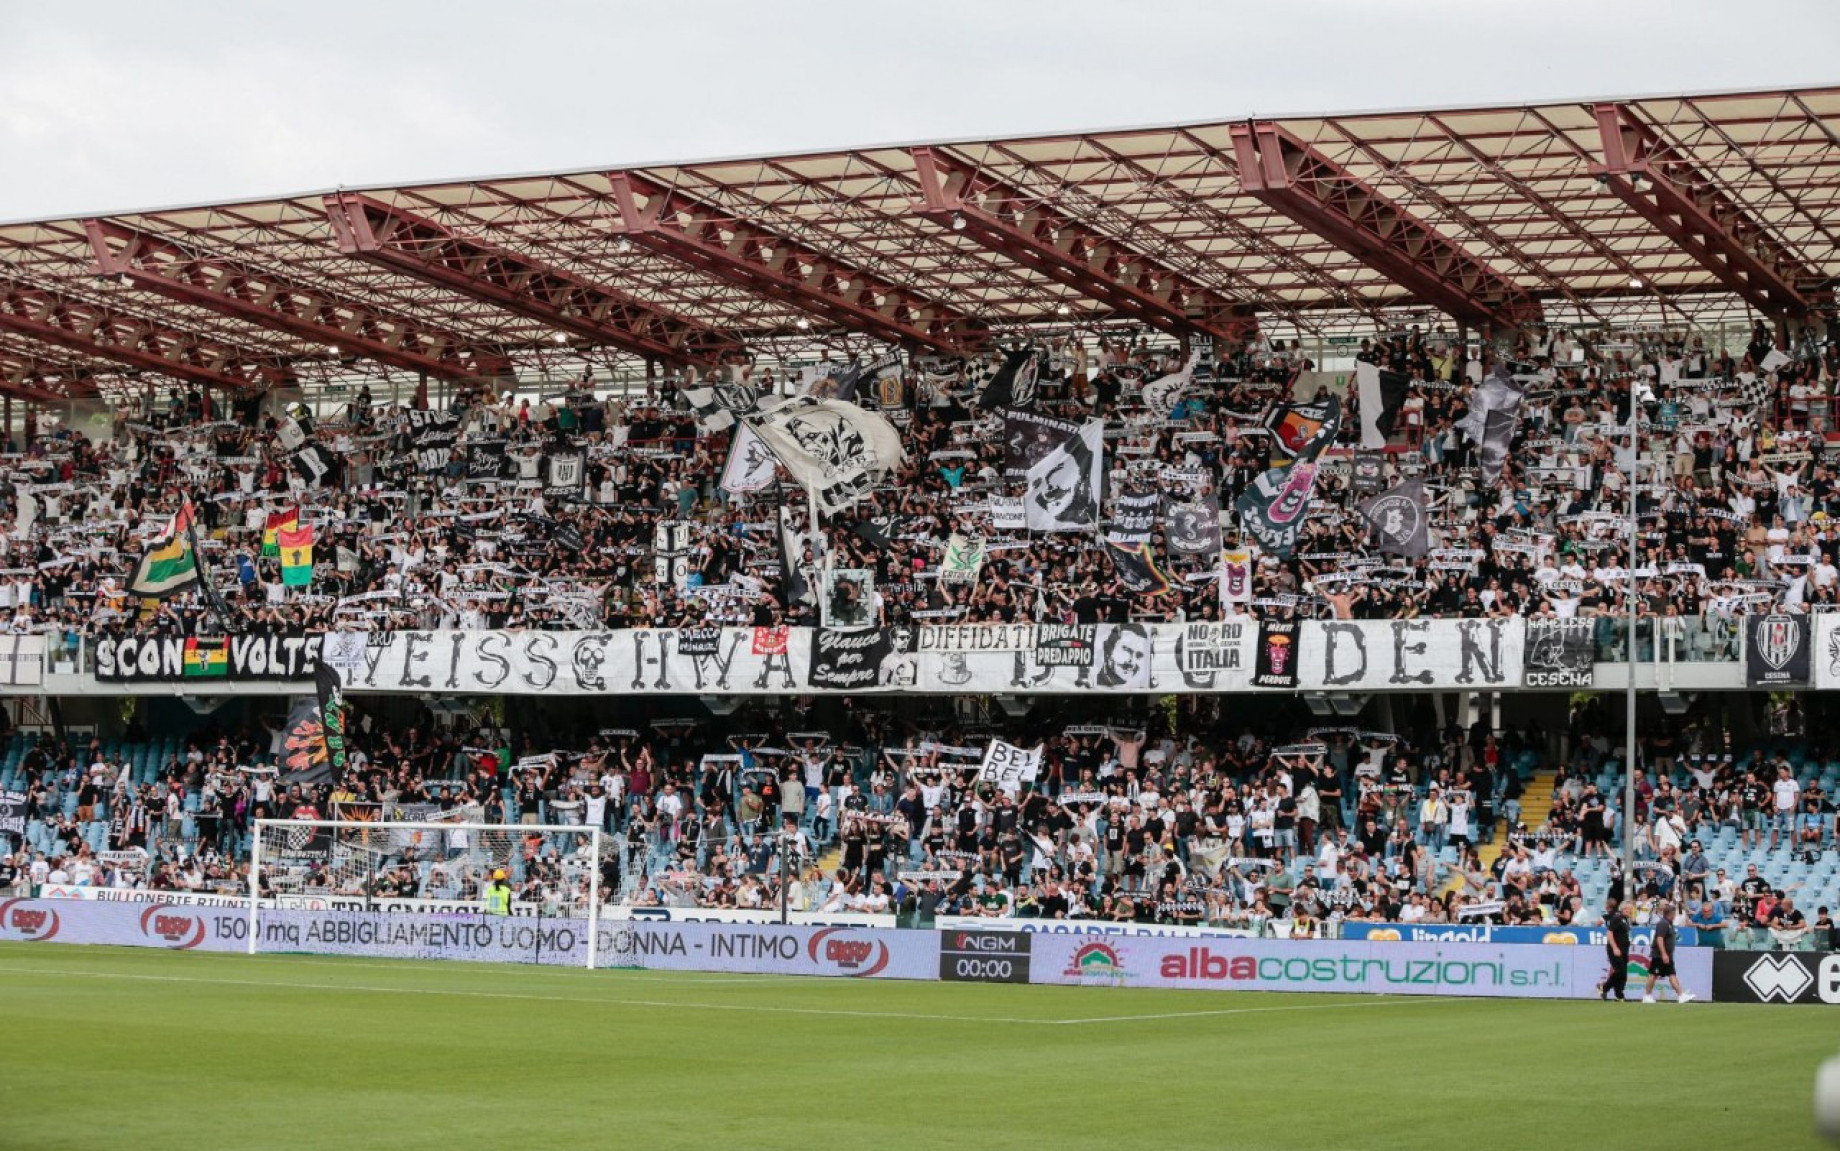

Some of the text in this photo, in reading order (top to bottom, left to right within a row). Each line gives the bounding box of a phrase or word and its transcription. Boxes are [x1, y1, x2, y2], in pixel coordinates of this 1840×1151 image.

[919, 624, 1037, 650] DIFFIDATI
[1040, 623, 1095, 642] BRIGATE
[836, 651, 863, 668] per
[1037, 647, 1092, 665] PREDAPPIO
[1188, 648, 1240, 668] ITALIA
[813, 663, 875, 688] Sempre
[991, 742, 1033, 767] BEL
[213, 916, 260, 940] 1500
[266, 923, 300, 946] mq
[305, 919, 493, 948] ABBIGLIAMENTO
[500, 925, 576, 951] UOMO
[597, 930, 688, 957] DONNA
[710, 932, 798, 960] INTIMO
[956, 959, 1012, 978] 00:00
